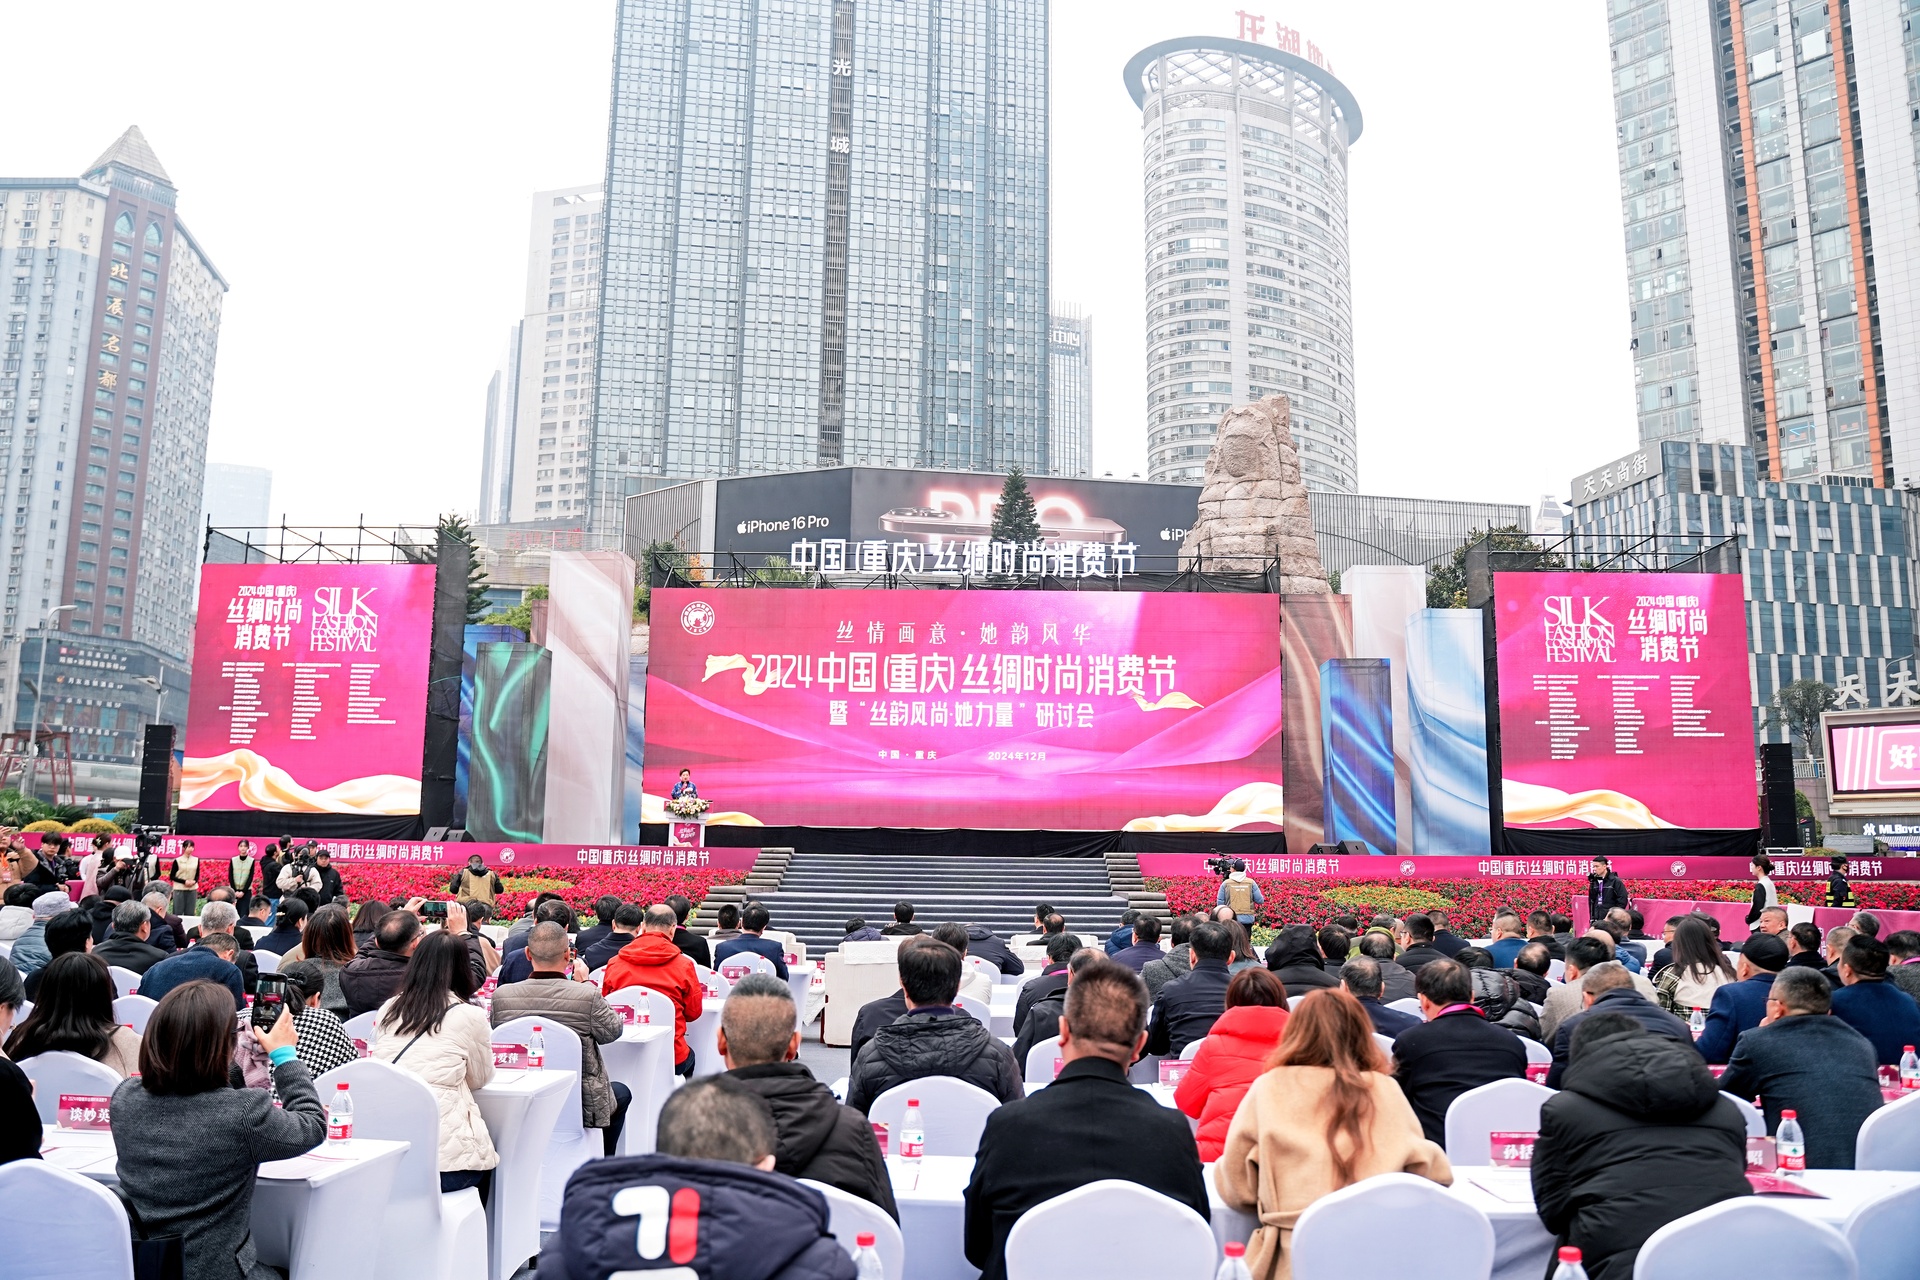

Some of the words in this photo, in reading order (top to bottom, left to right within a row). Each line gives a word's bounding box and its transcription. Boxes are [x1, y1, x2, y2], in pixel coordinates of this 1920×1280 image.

[831, 58, 852, 154] 光城
[98, 262, 129, 390] 北辰名都
[1583, 453, 1647, 499] 天天尚街
[747, 518, 790, 534] iPhone
[791, 516, 806, 530] 16
[808, 514, 830, 529] Pro
[1171, 528, 1187, 541] iP
[226, 597, 302, 624] 丝绸时尚
[312, 586, 378, 616] SILK
[1544, 595, 1614, 626] SILK
[312, 614, 378, 631] FASHION
[1545, 624, 1615, 641] FASHION
[1627, 608, 1708, 635] 丝绸时尚
[234, 624, 291, 650] 消费节
[310, 636, 377, 652] FESTIVAL
[1640, 636, 1699, 662] 消费节
[1546, 646, 1617, 662] FESTIVAL
[1834, 670, 1920, 706] 天天
[878, 750, 937, 760] 中国·重庆
[988, 752, 1047, 762] 2024年12月
[1888, 744, 1917, 770] 好
[577, 849, 710, 867] 中国(重庆)丝绸时尚消费节
